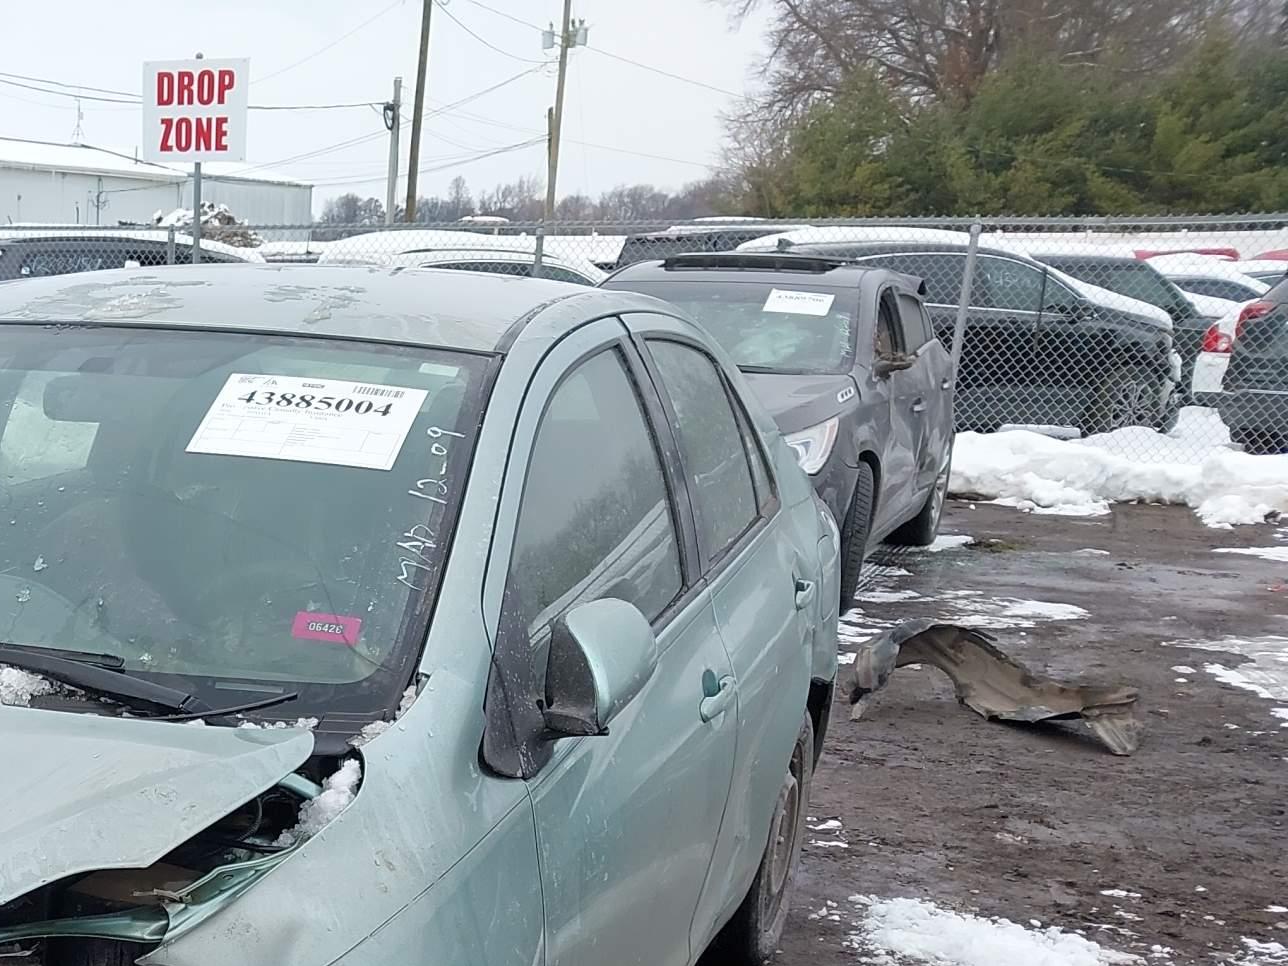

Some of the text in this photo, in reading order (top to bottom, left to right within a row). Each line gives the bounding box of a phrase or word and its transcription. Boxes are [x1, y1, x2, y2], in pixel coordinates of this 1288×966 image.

[157, 70, 234, 106] DROP
[160, 117, 228, 152] ZONE
[238, 390, 393, 417] 43885004
